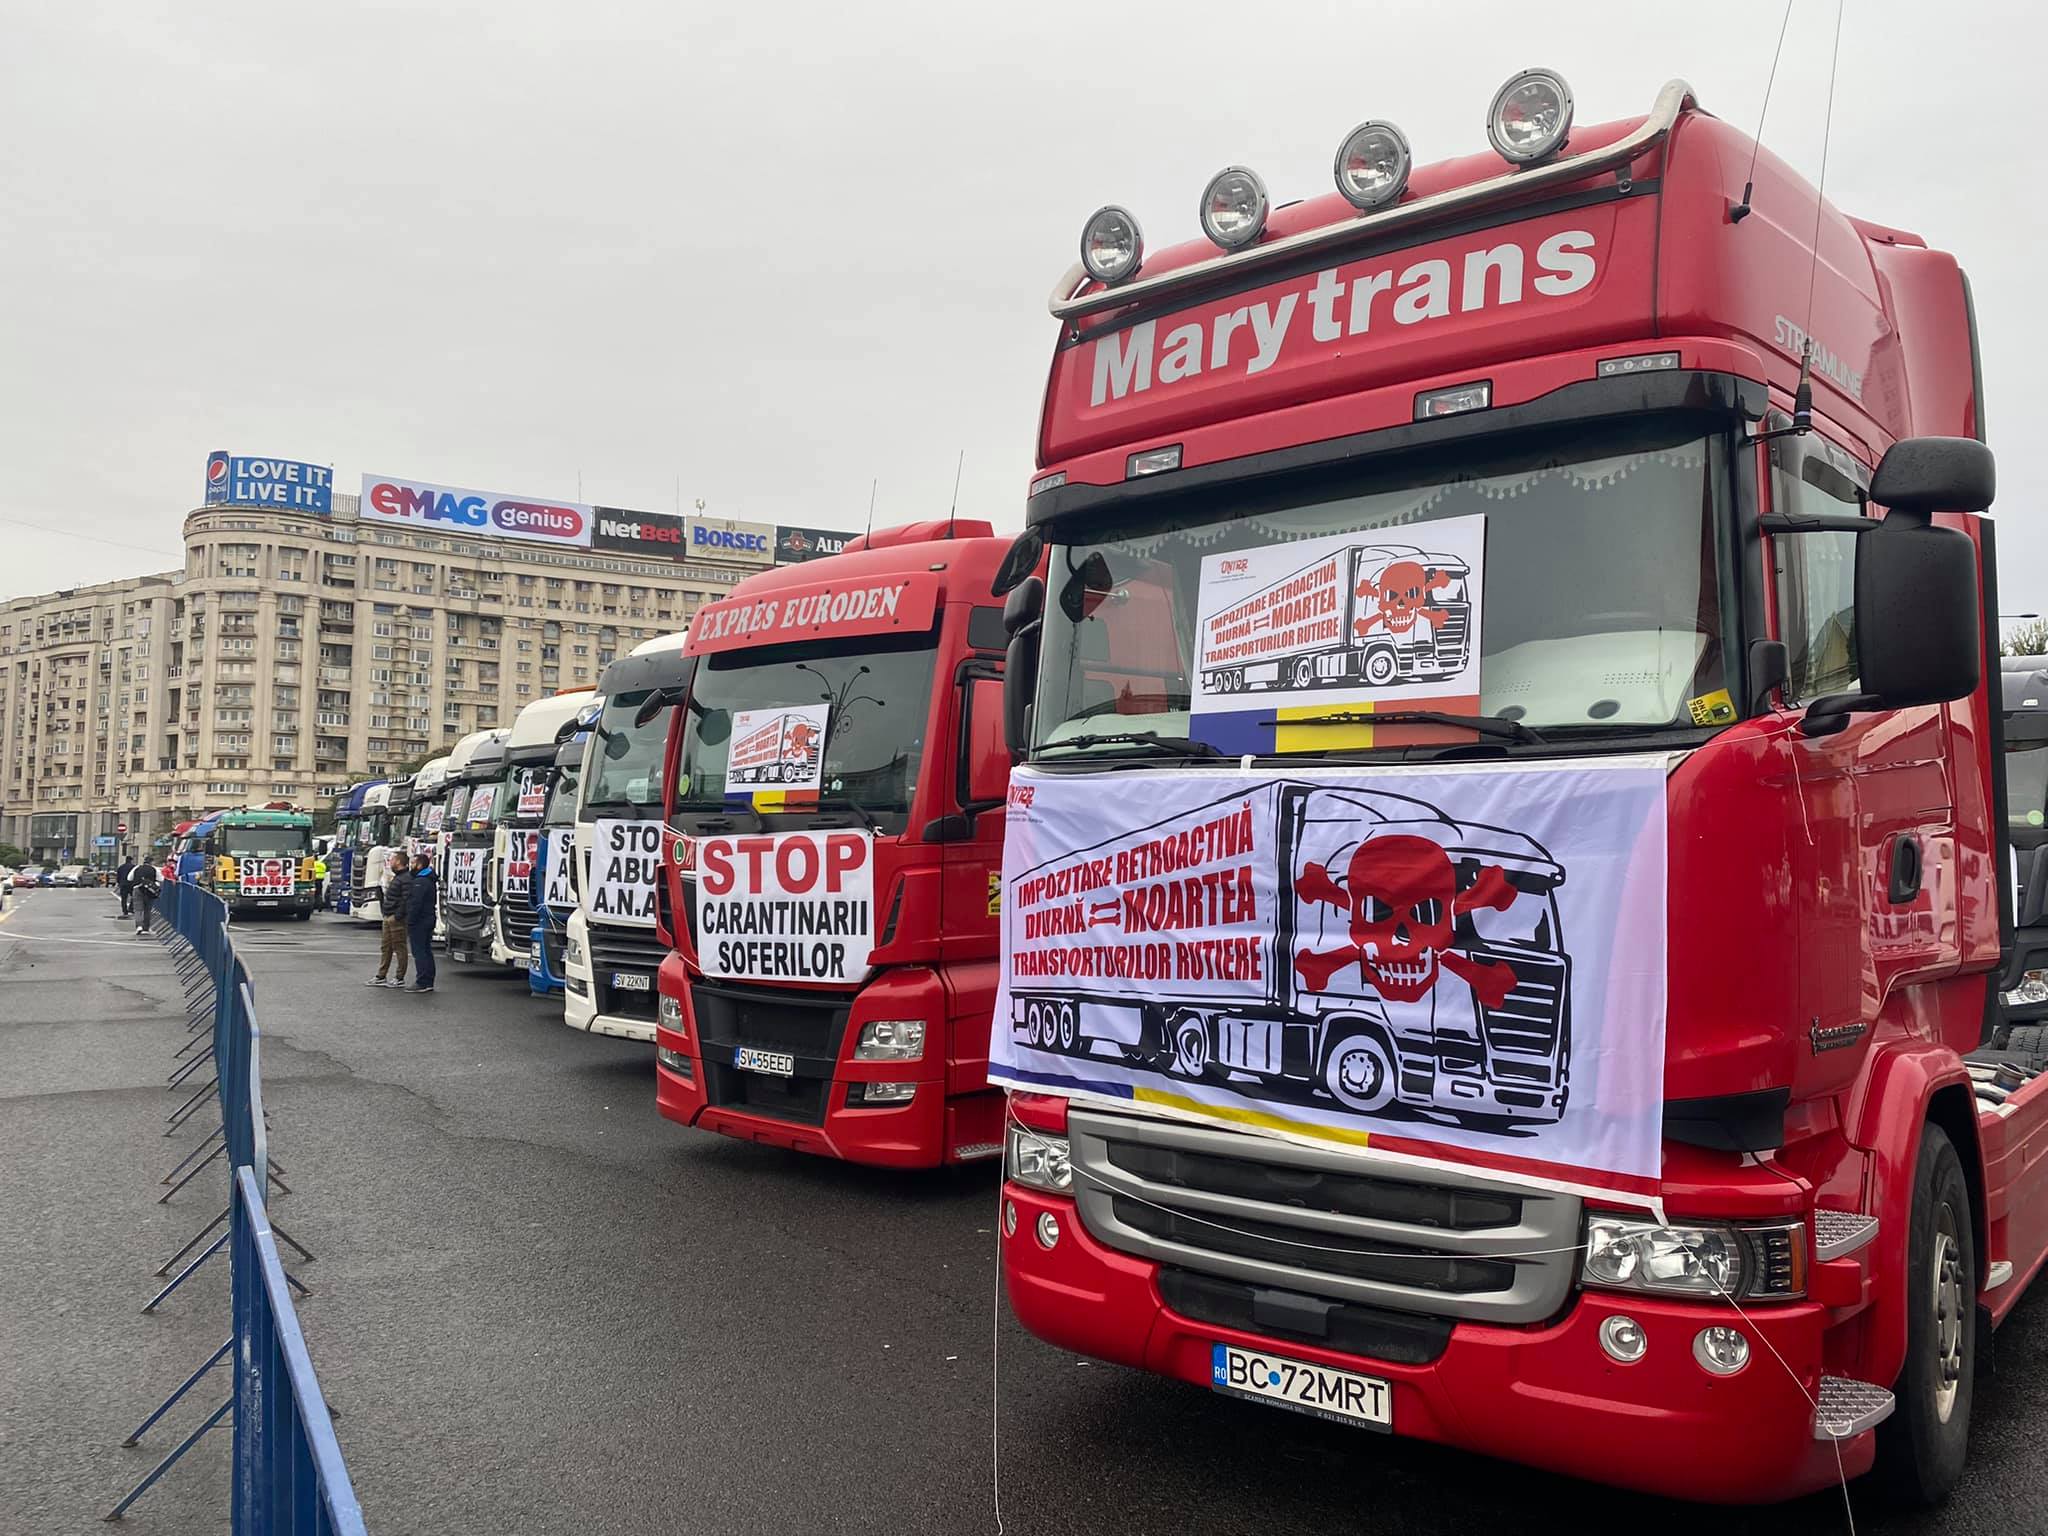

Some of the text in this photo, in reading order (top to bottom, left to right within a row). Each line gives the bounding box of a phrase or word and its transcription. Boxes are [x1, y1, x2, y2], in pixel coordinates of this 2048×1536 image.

[1089, 230, 1597, 407] Marytrans
[237, 460, 331, 488] LOVE IT.
[236, 482, 322, 507] LIVE IT.
[371, 483, 574, 530] eMAG genius
[600, 519, 681, 544] NetBet
[693, 526, 767, 551] BORSEC
[780, 585, 904, 630] EURODEN
[1210, 557, 1337, 631] IMPOZITARE RETROACTIVĂ
[1271, 585, 1337, 629] MOARTEA
[1205, 615, 1339, 663] TRANSPORTURILOR RUTIERE
[610, 825, 660, 853] STO
[1018, 800, 1254, 909] IMPOZITARE RETROACTIVĂ
[453, 870, 475, 884] ABUZ
[455, 852, 475, 867] STOP
[507, 863, 529, 877] AB
[606, 857, 657, 885] ABU
[702, 833, 867, 896] STOP
[593, 887, 657, 918] A.N.A
[703, 900, 867, 936] CARANTINARII
[1025, 865, 1257, 940] DIURNĂ MOARTEA
[718, 941, 845, 978] SOFERILOR
[1013, 936, 1262, 981] TRANSPORTURILOR RUTIERE
[740, 1050, 793, 1072] SV 55EED
[1214, 1352, 1385, 1417] RO BC 72MRT
